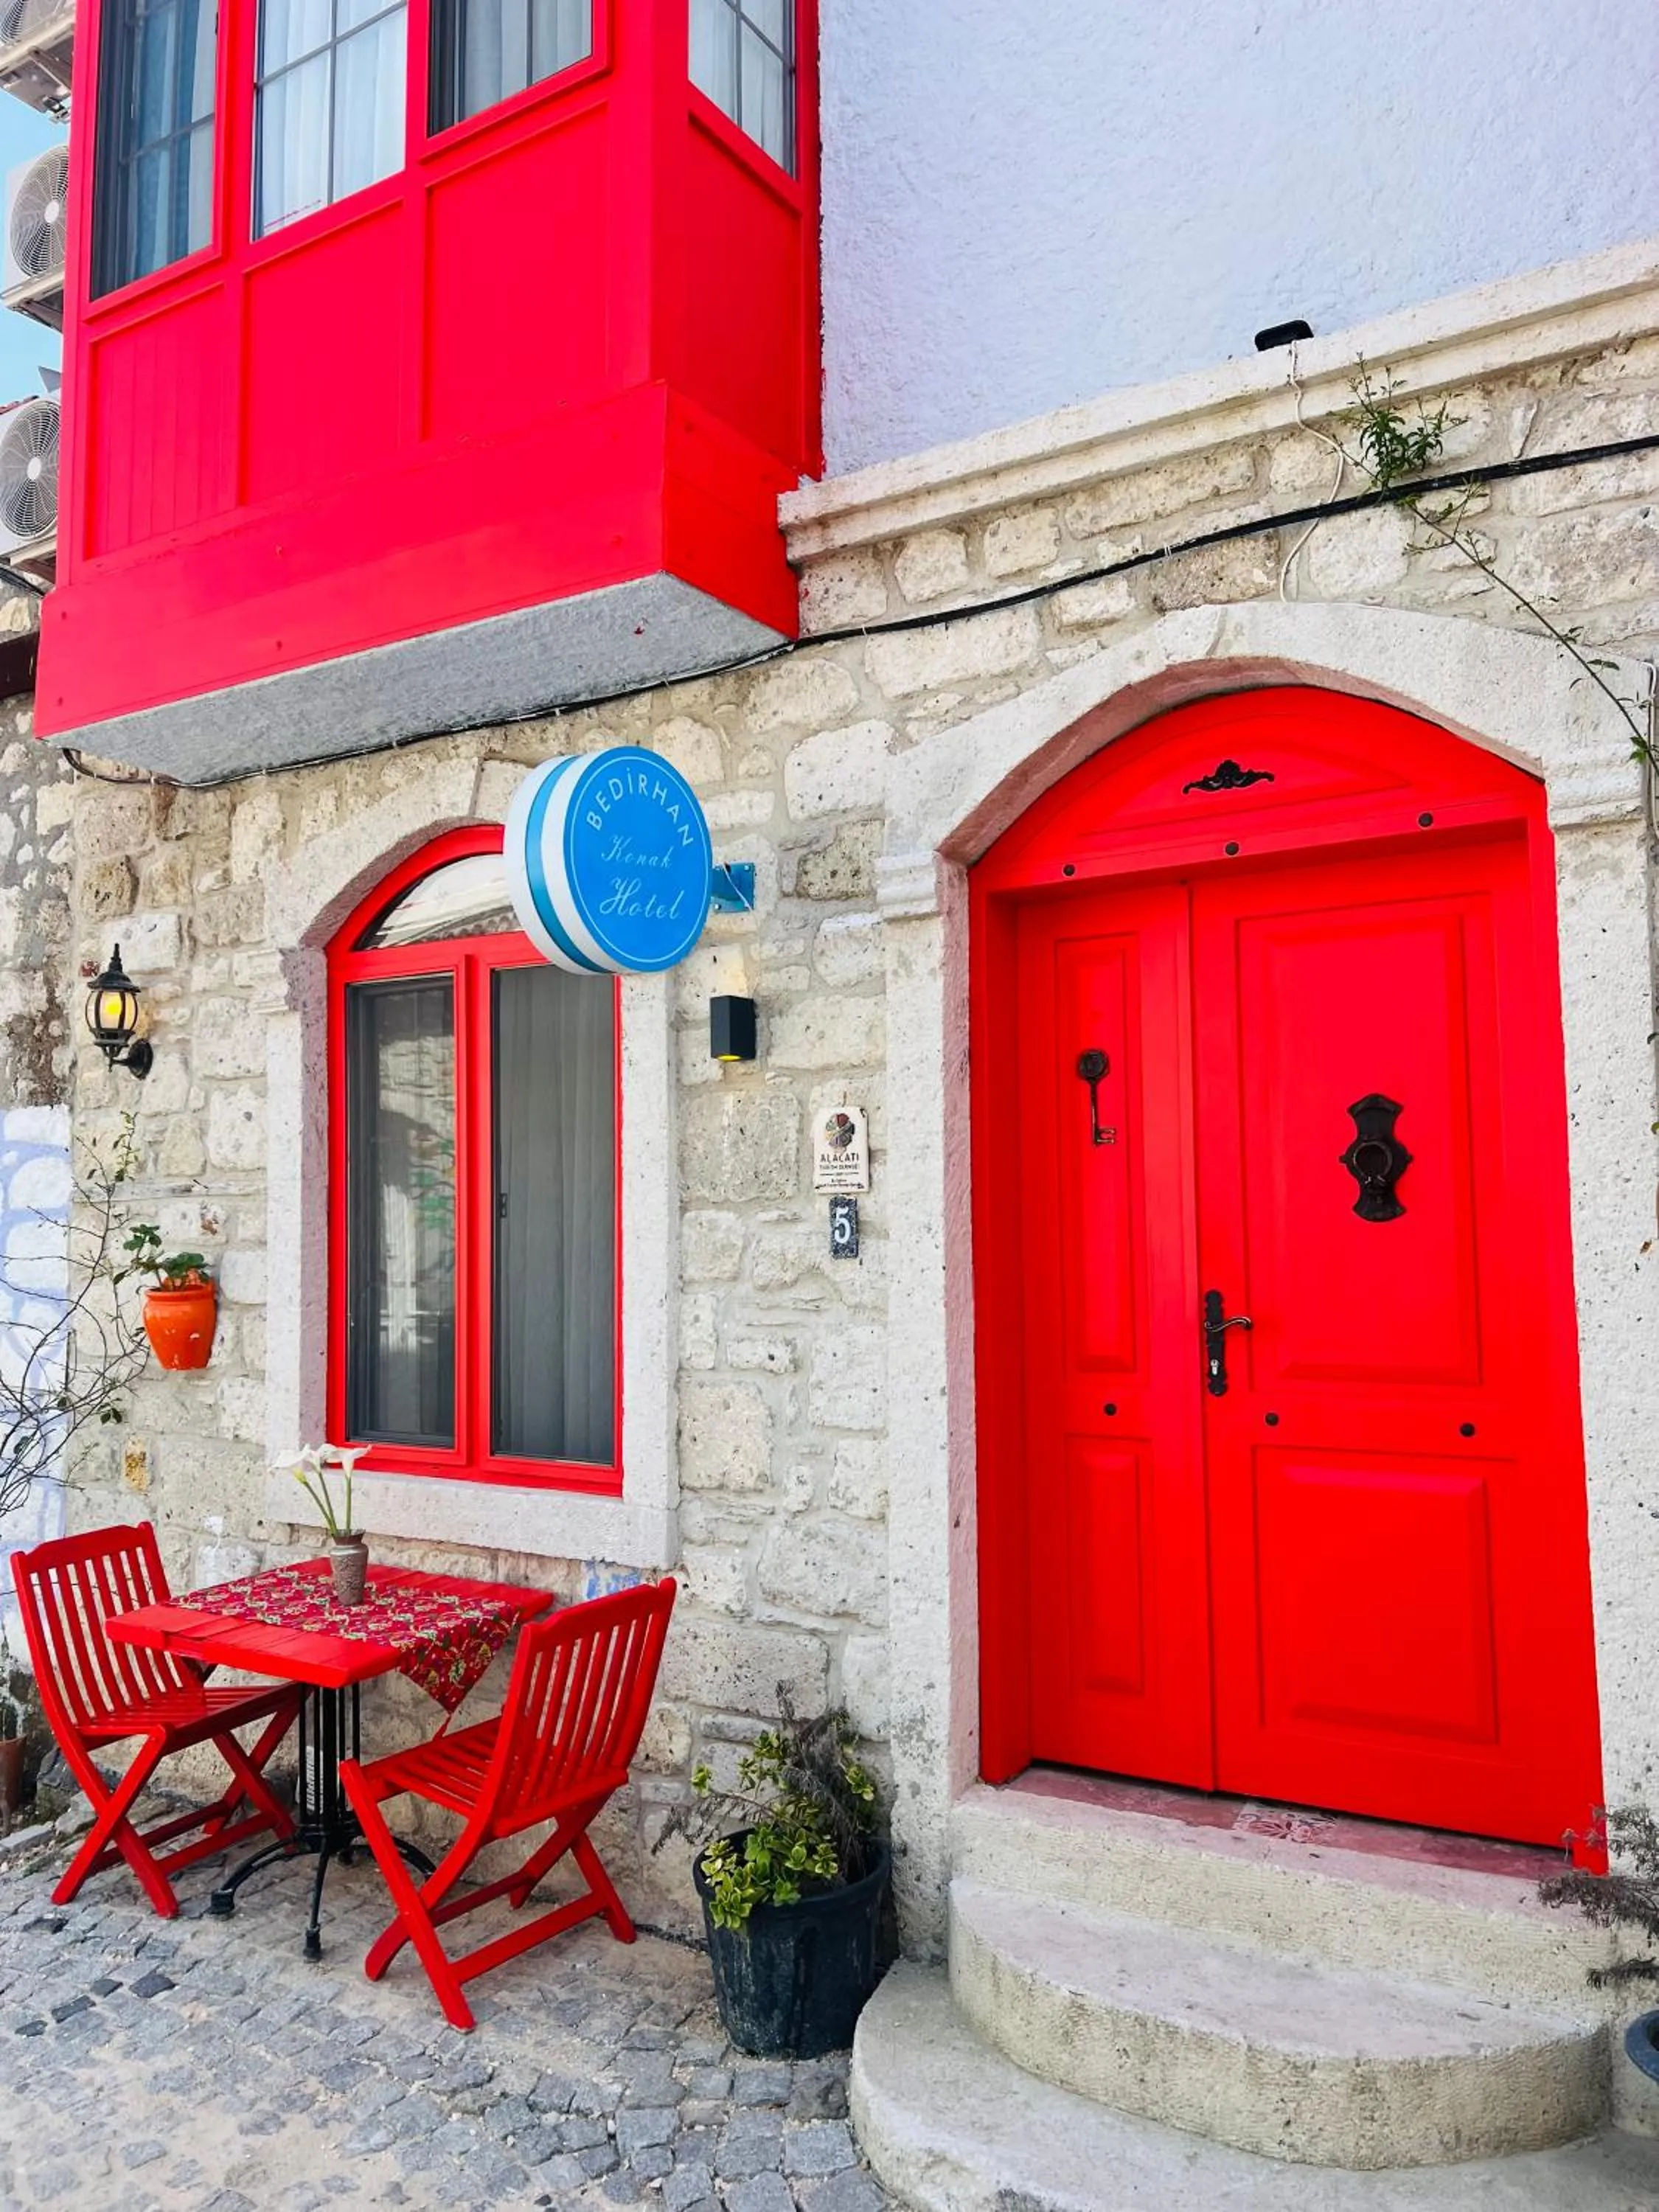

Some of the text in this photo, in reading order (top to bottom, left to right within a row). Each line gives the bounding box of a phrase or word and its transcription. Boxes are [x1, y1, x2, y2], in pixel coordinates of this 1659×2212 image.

[601, 835, 675, 869] Konak
[599, 877, 686, 920] Hotel
[834, 1206, 851, 1244] 5
